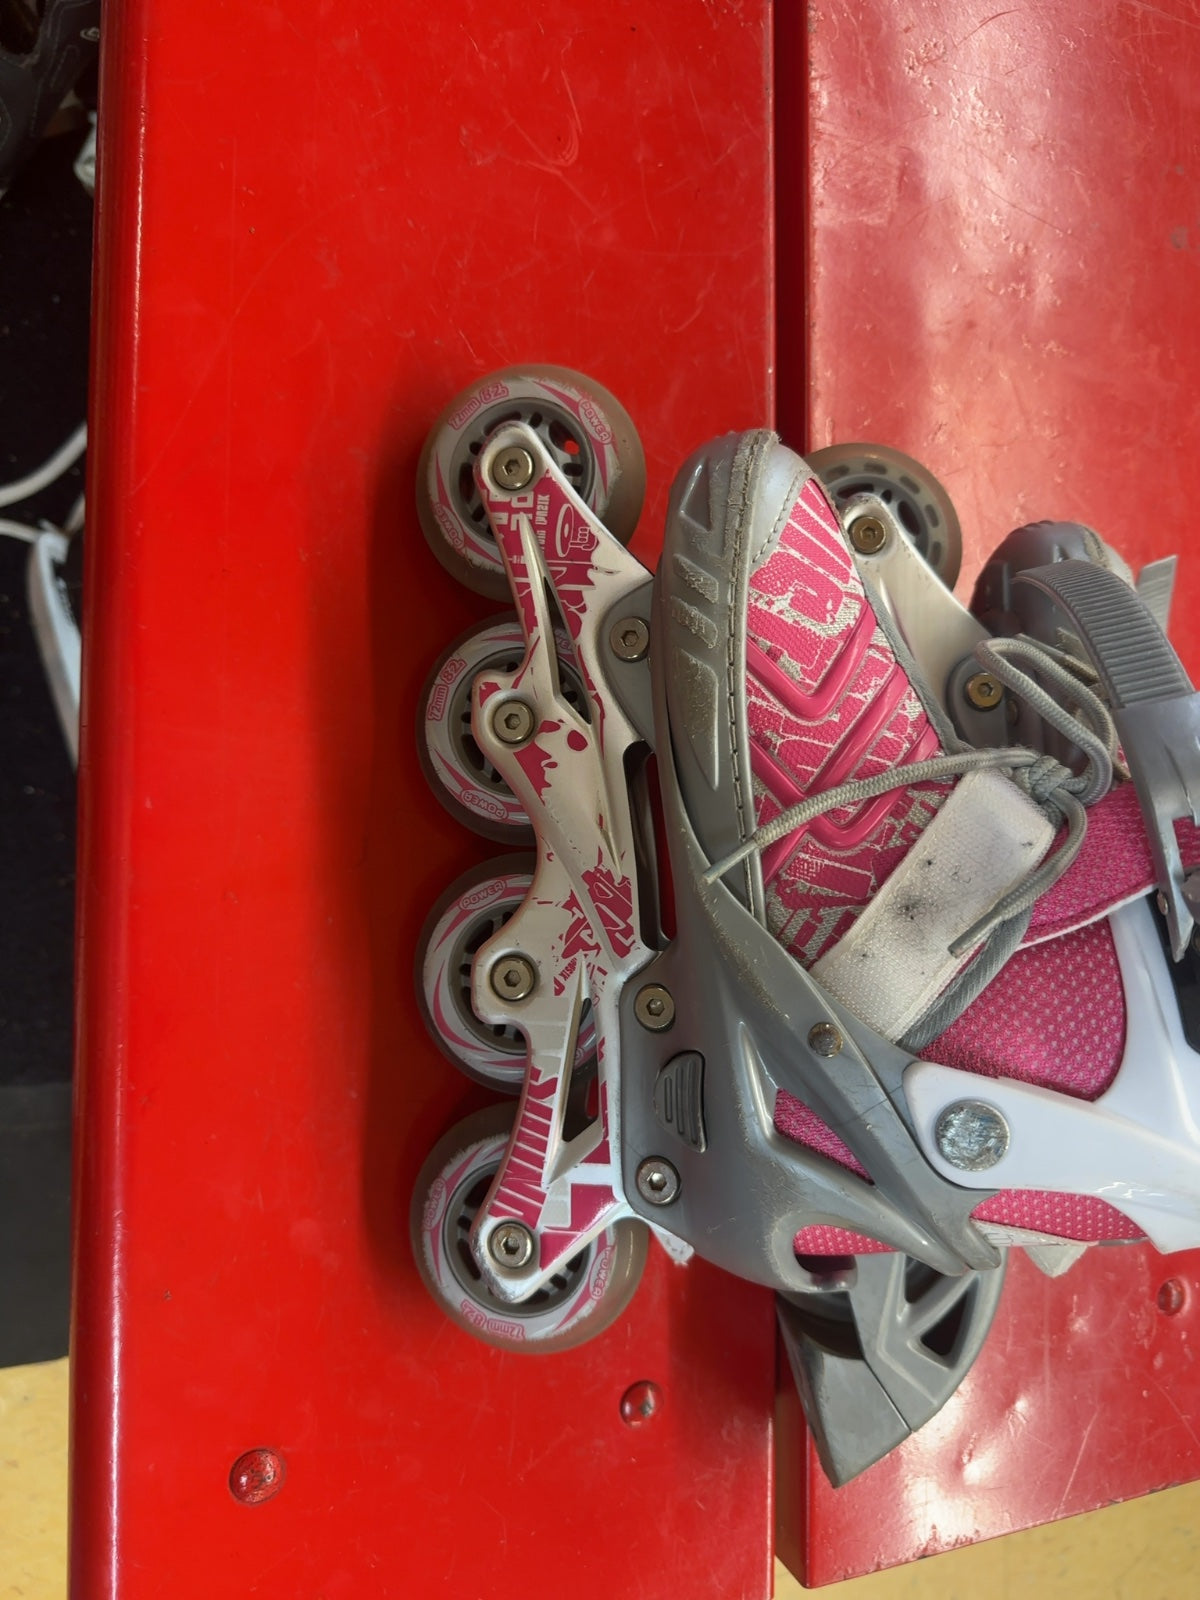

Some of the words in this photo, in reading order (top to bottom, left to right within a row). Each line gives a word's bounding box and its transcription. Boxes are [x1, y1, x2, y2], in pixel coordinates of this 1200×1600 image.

[580, 399, 611, 444] POWER
[434, 503, 464, 550] POWER
[428, 683, 448, 721] 72mm
[462, 791, 507, 819] POWER
[461, 881, 504, 910] POWER
[424, 1179, 444, 1229] POWER
